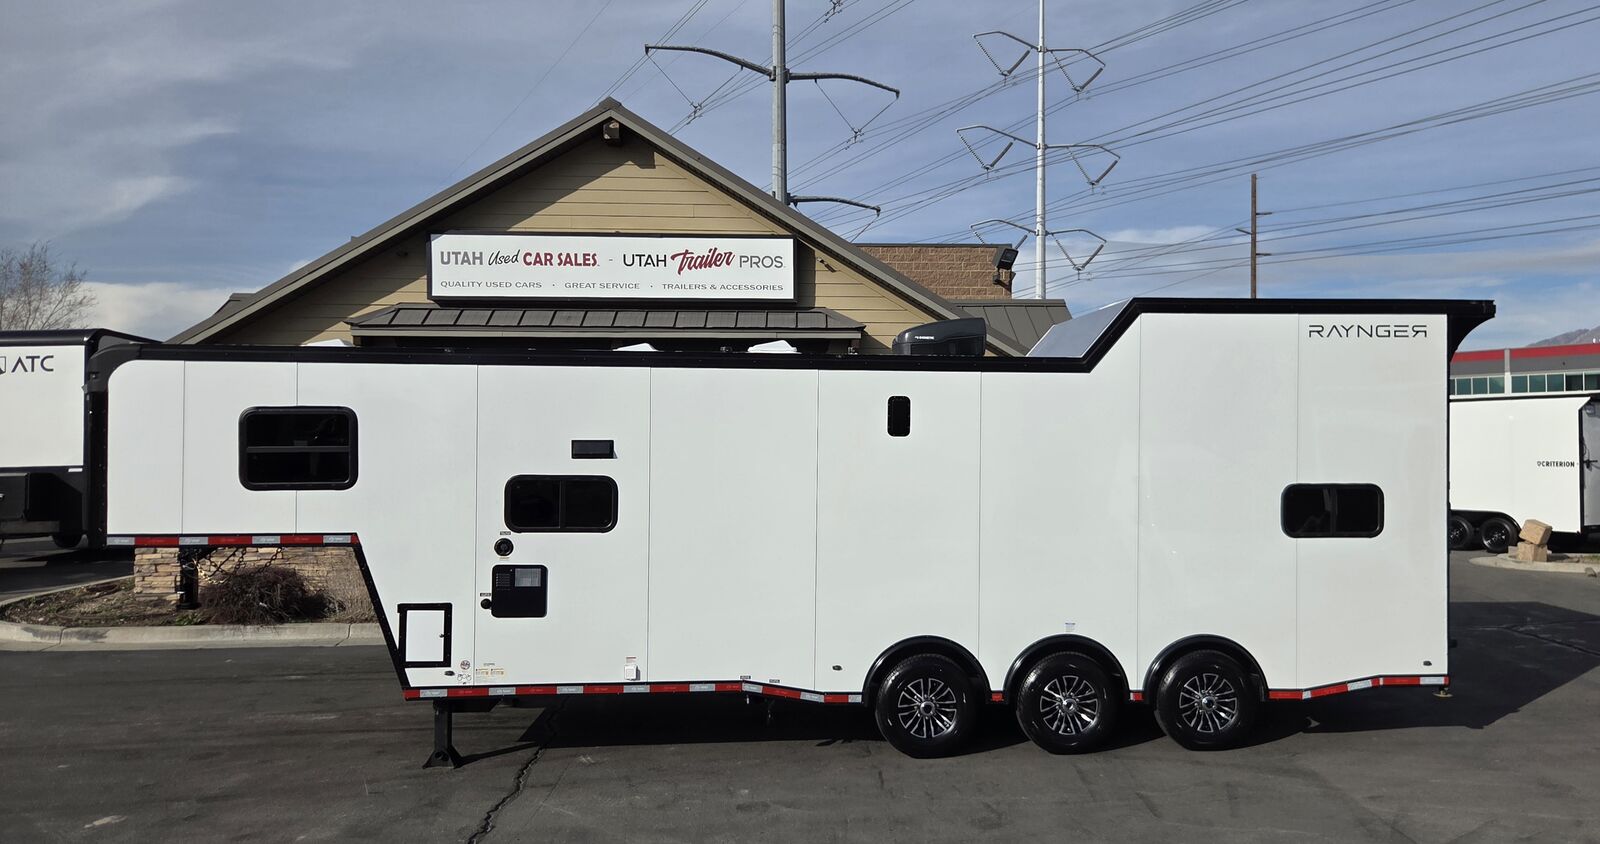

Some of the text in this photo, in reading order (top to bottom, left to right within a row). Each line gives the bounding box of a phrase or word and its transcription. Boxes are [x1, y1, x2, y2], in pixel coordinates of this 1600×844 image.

[440, 251, 483, 266] UTAH
[488, 249, 520, 266] Used
[523, 252, 553, 267] CAR
[623, 254, 667, 267] UTAH
[670, 247, 735, 275] Trailer
[440, 280, 482, 289] QUALITY
[11, 355, 54, 373] ATC
